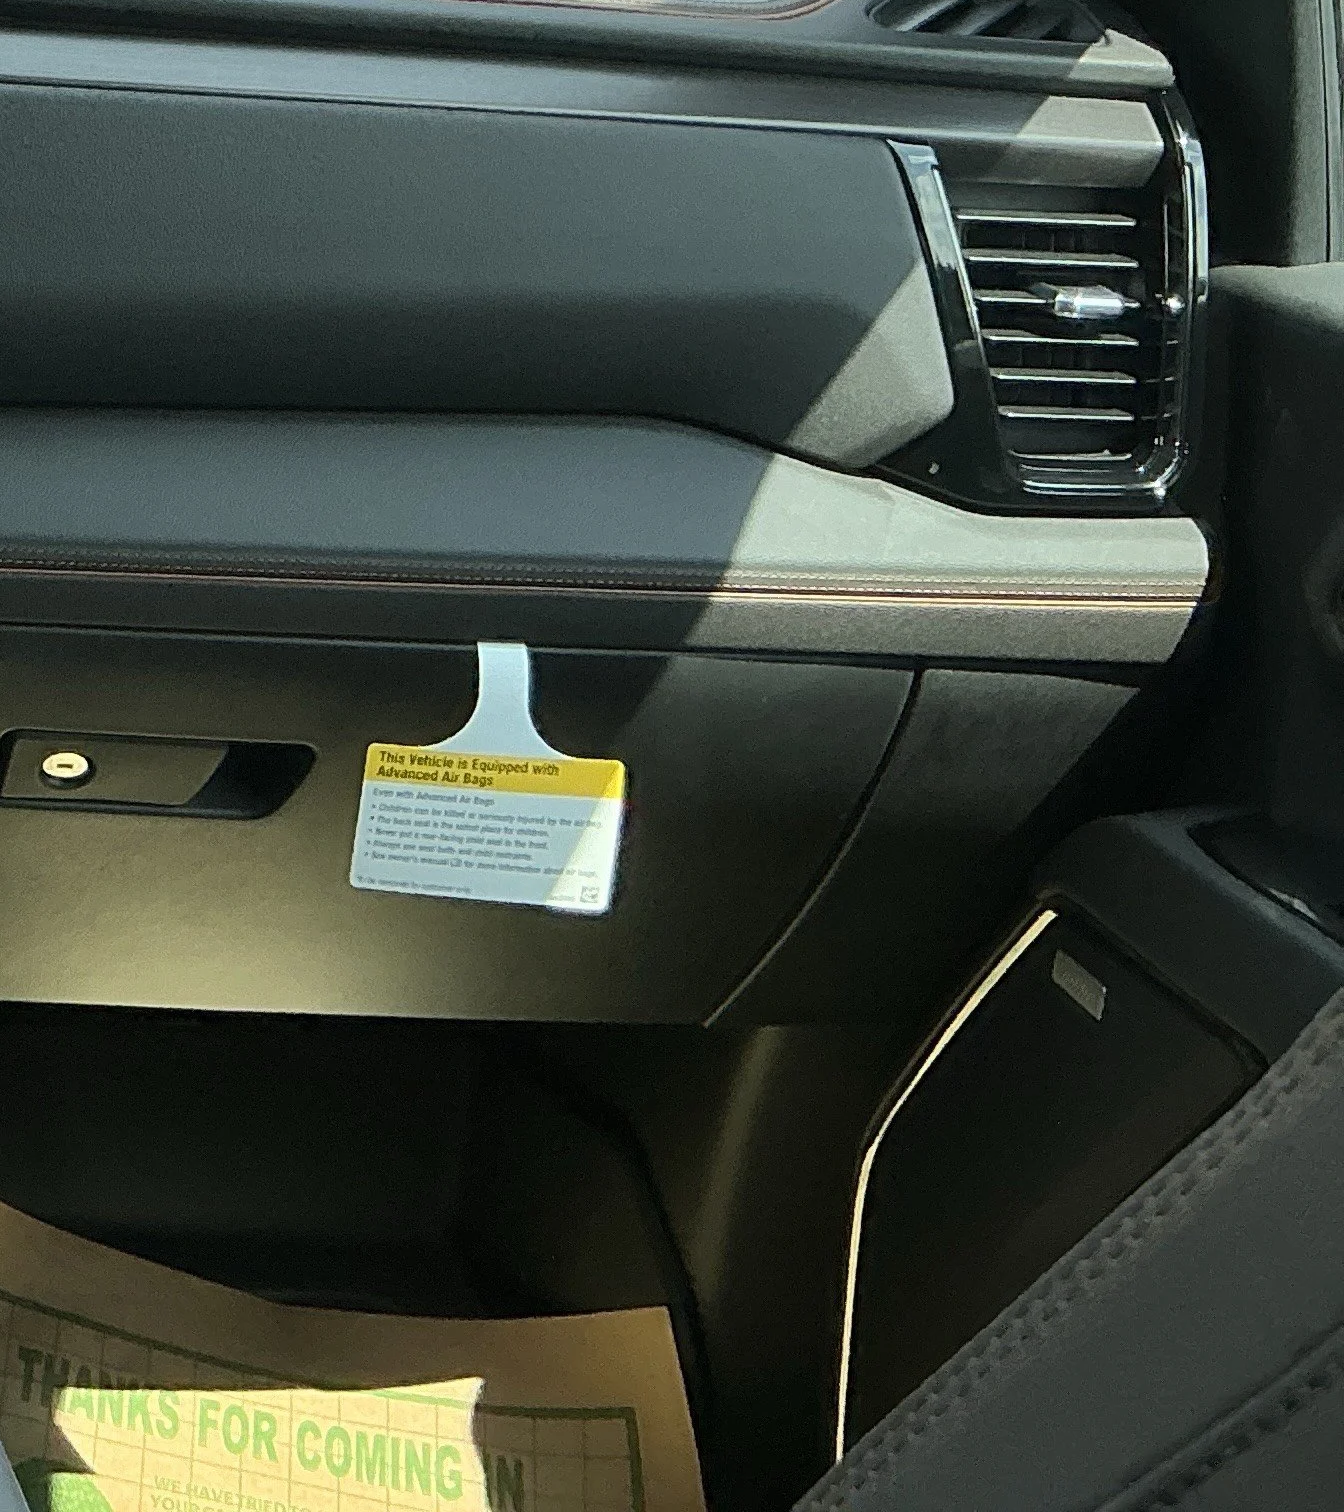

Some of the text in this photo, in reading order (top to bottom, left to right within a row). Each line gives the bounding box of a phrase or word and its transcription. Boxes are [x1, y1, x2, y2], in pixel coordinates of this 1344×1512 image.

[379, 750, 560, 776] This Vehicle is Equipped with
[376, 765, 493, 787] Advanced Air Bags
[18, 1345, 525, 1512] THANKS FOR COMING IN
[186, 1482, 233, 1505] HAVE
